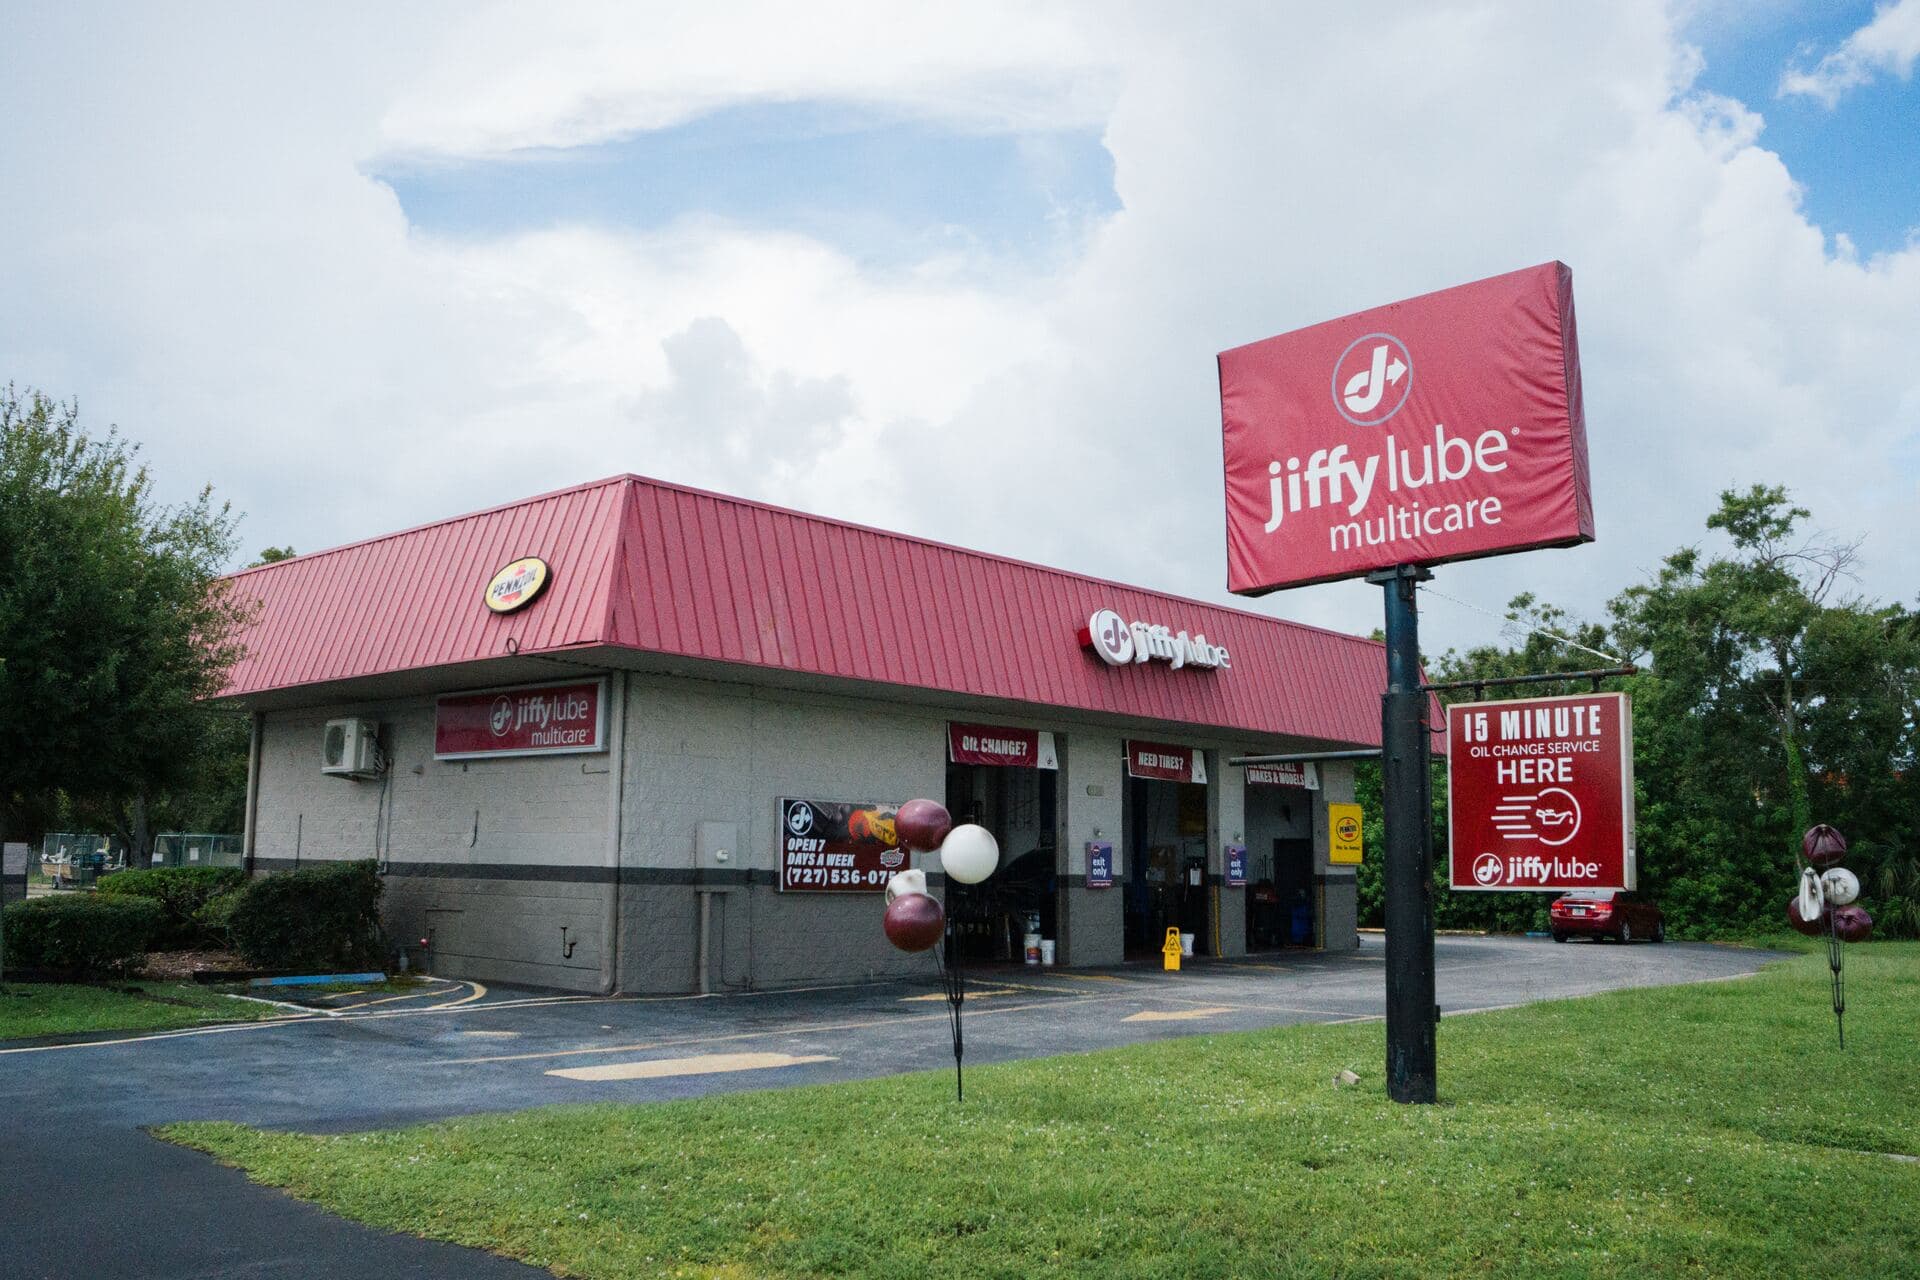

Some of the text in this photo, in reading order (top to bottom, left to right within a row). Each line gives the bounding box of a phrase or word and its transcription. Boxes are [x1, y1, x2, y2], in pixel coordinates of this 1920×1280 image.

[1329, 496, 1502, 552] multicare
[1464, 705, 1602, 743] 15 MINUTE
[531, 727, 587, 746] multicare
[961, 735, 1028, 757] OIL CHANGE?
[1470, 740, 1600, 758] OIL CHANGE SERVICE
[1138, 752, 1184, 771] NEED TIRES?
[1497, 757, 1574, 785] HERE
[1249, 769, 1273, 784] MAKES
[1279, 772, 1305, 786] MODELS
[787, 838, 826, 852] OPEN 7
[787, 852, 856, 867] DAYS A WEEK
[1093, 857, 1105, 866] exit
[786, 867, 829, 887] (727)
[1093, 866, 1107, 878] only
